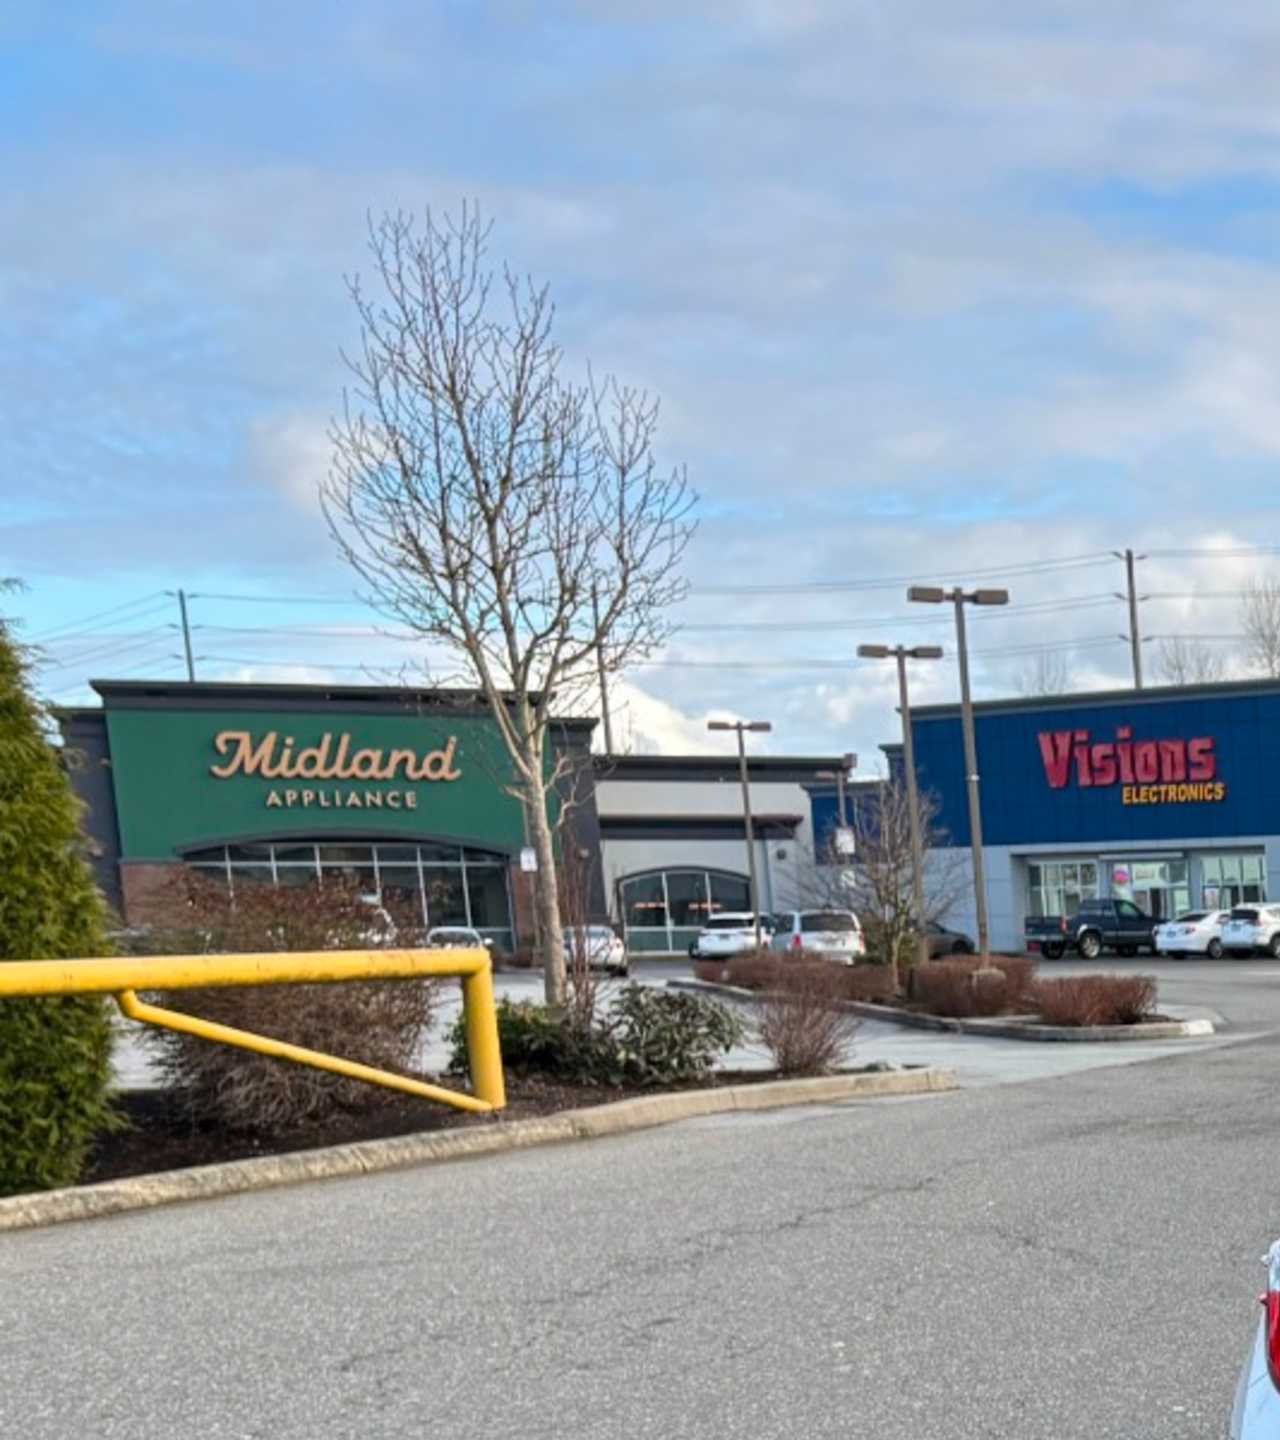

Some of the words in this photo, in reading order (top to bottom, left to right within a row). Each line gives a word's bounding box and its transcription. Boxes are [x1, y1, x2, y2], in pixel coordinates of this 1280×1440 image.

[211, 730, 461, 780] Midland
[1038, 726, 1216, 788] Visions
[266, 790, 418, 809] APPLIANCE
[1122, 782, 1226, 805] ELECTRONICS
